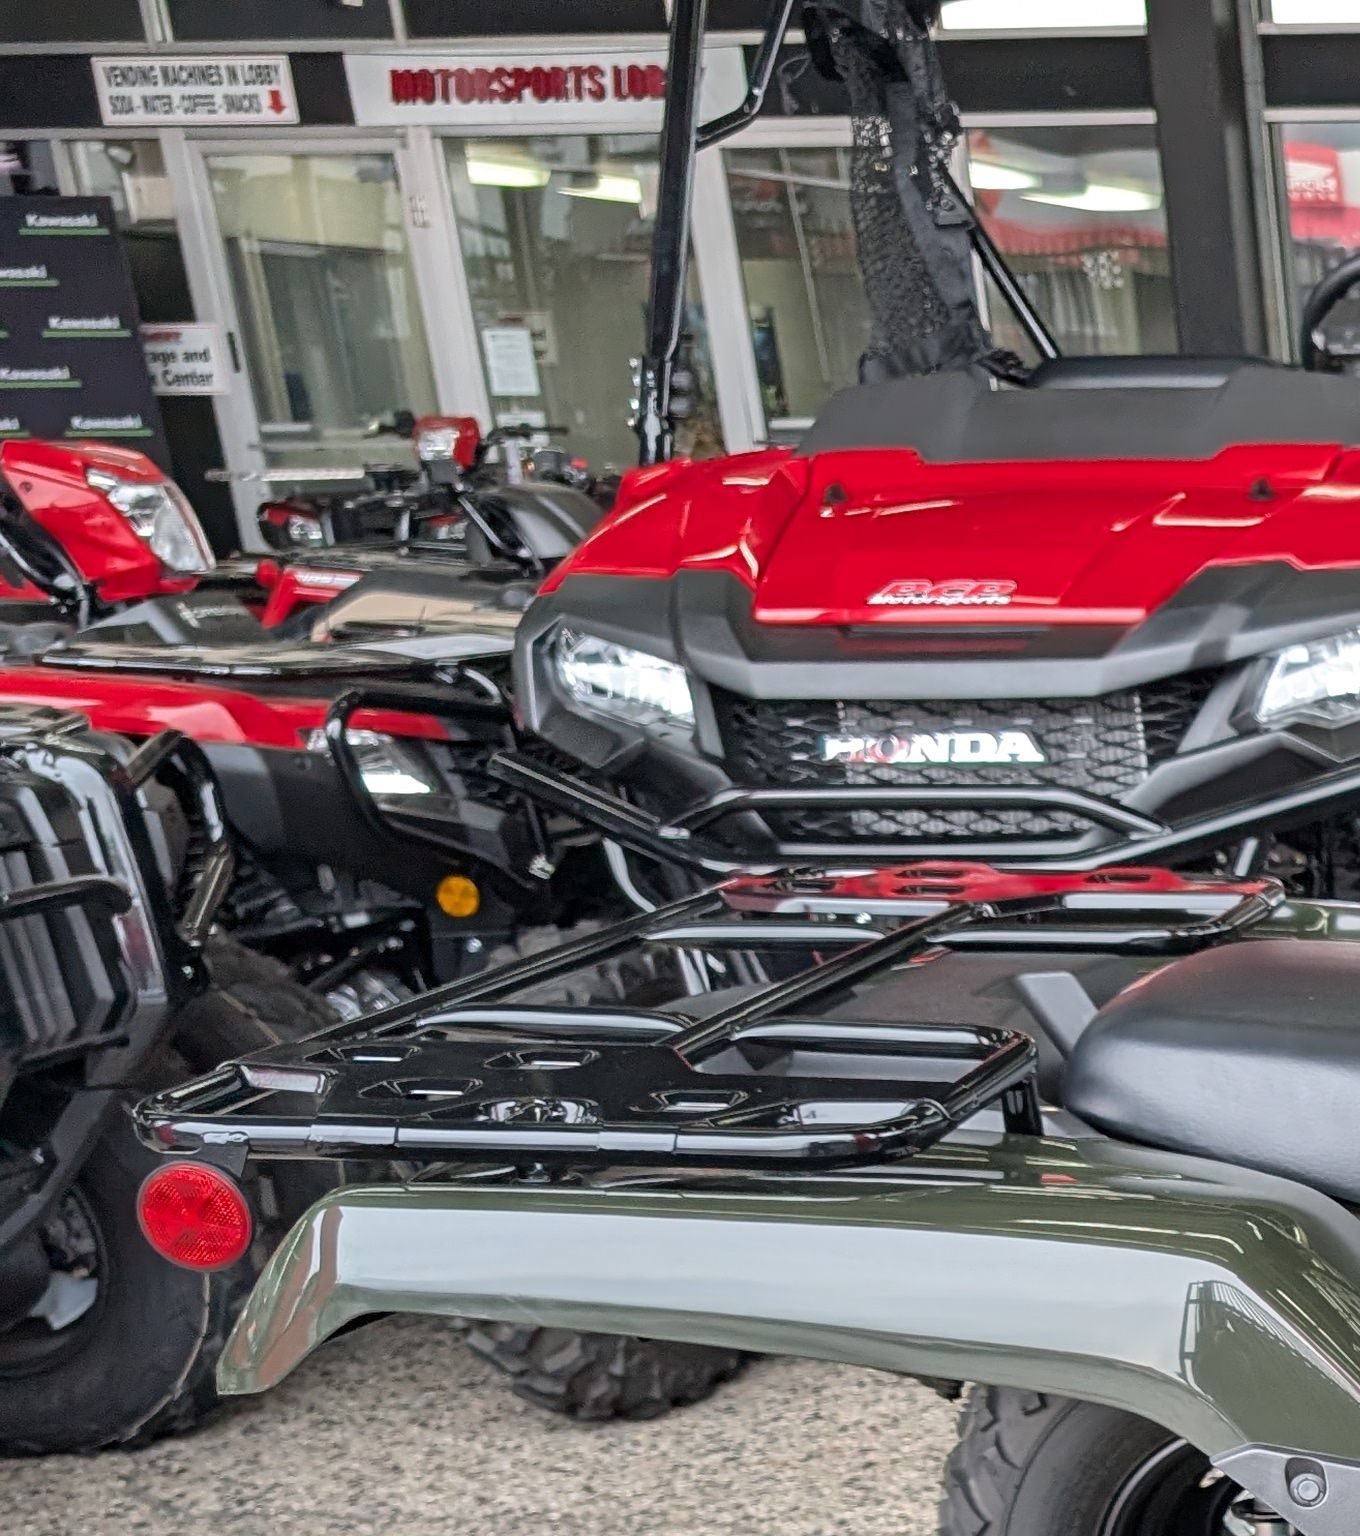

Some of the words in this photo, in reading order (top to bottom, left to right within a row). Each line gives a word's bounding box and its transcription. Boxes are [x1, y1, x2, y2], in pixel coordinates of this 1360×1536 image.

[102, 65, 158, 87] VENDING
[159, 65, 224, 87] MACHINES
[224, 65, 240, 86] IN
[241, 64, 280, 86] LOBBY
[390, 66, 606, 106] MOTORSPORTS
[613, 63, 667, 100] LOB
[108, 94, 134, 115] SODA
[223, 93, 263, 114] SNACKS
[820, 730, 1046, 764] HONDA
